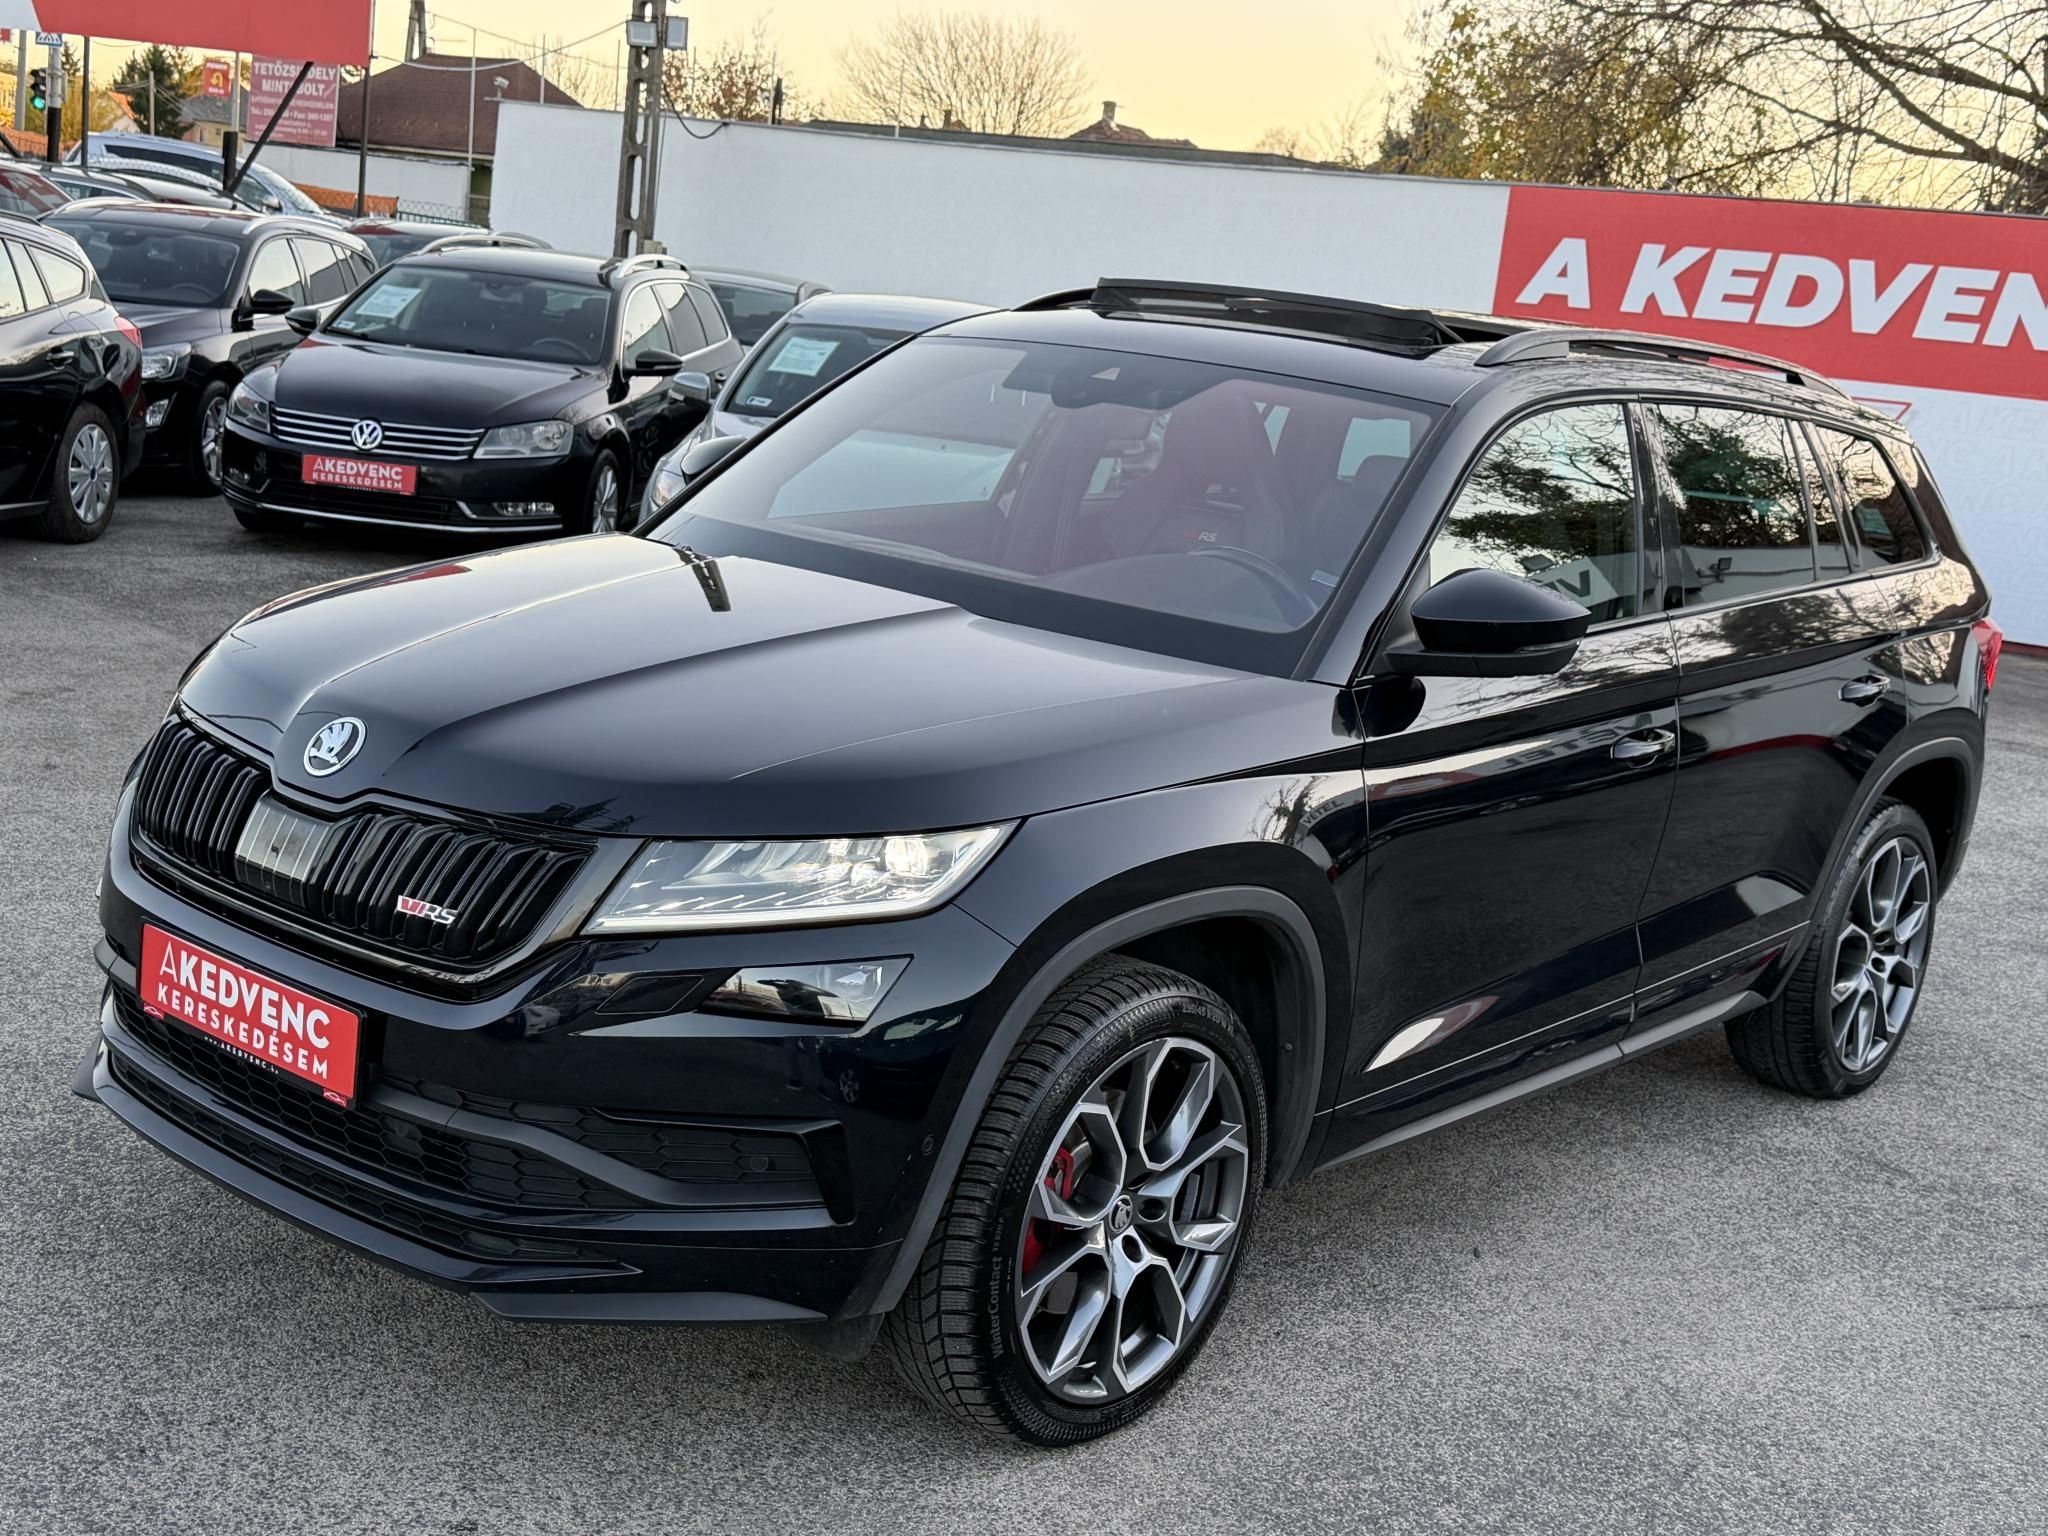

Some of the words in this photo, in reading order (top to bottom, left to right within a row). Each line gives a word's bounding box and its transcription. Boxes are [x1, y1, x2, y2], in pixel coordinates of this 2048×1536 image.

[1515, 237, 1590, 309] A
[157, 982, 329, 1079] KERESKEDÉSEM
[987, 1255, 1004, 1359] WinterContact
